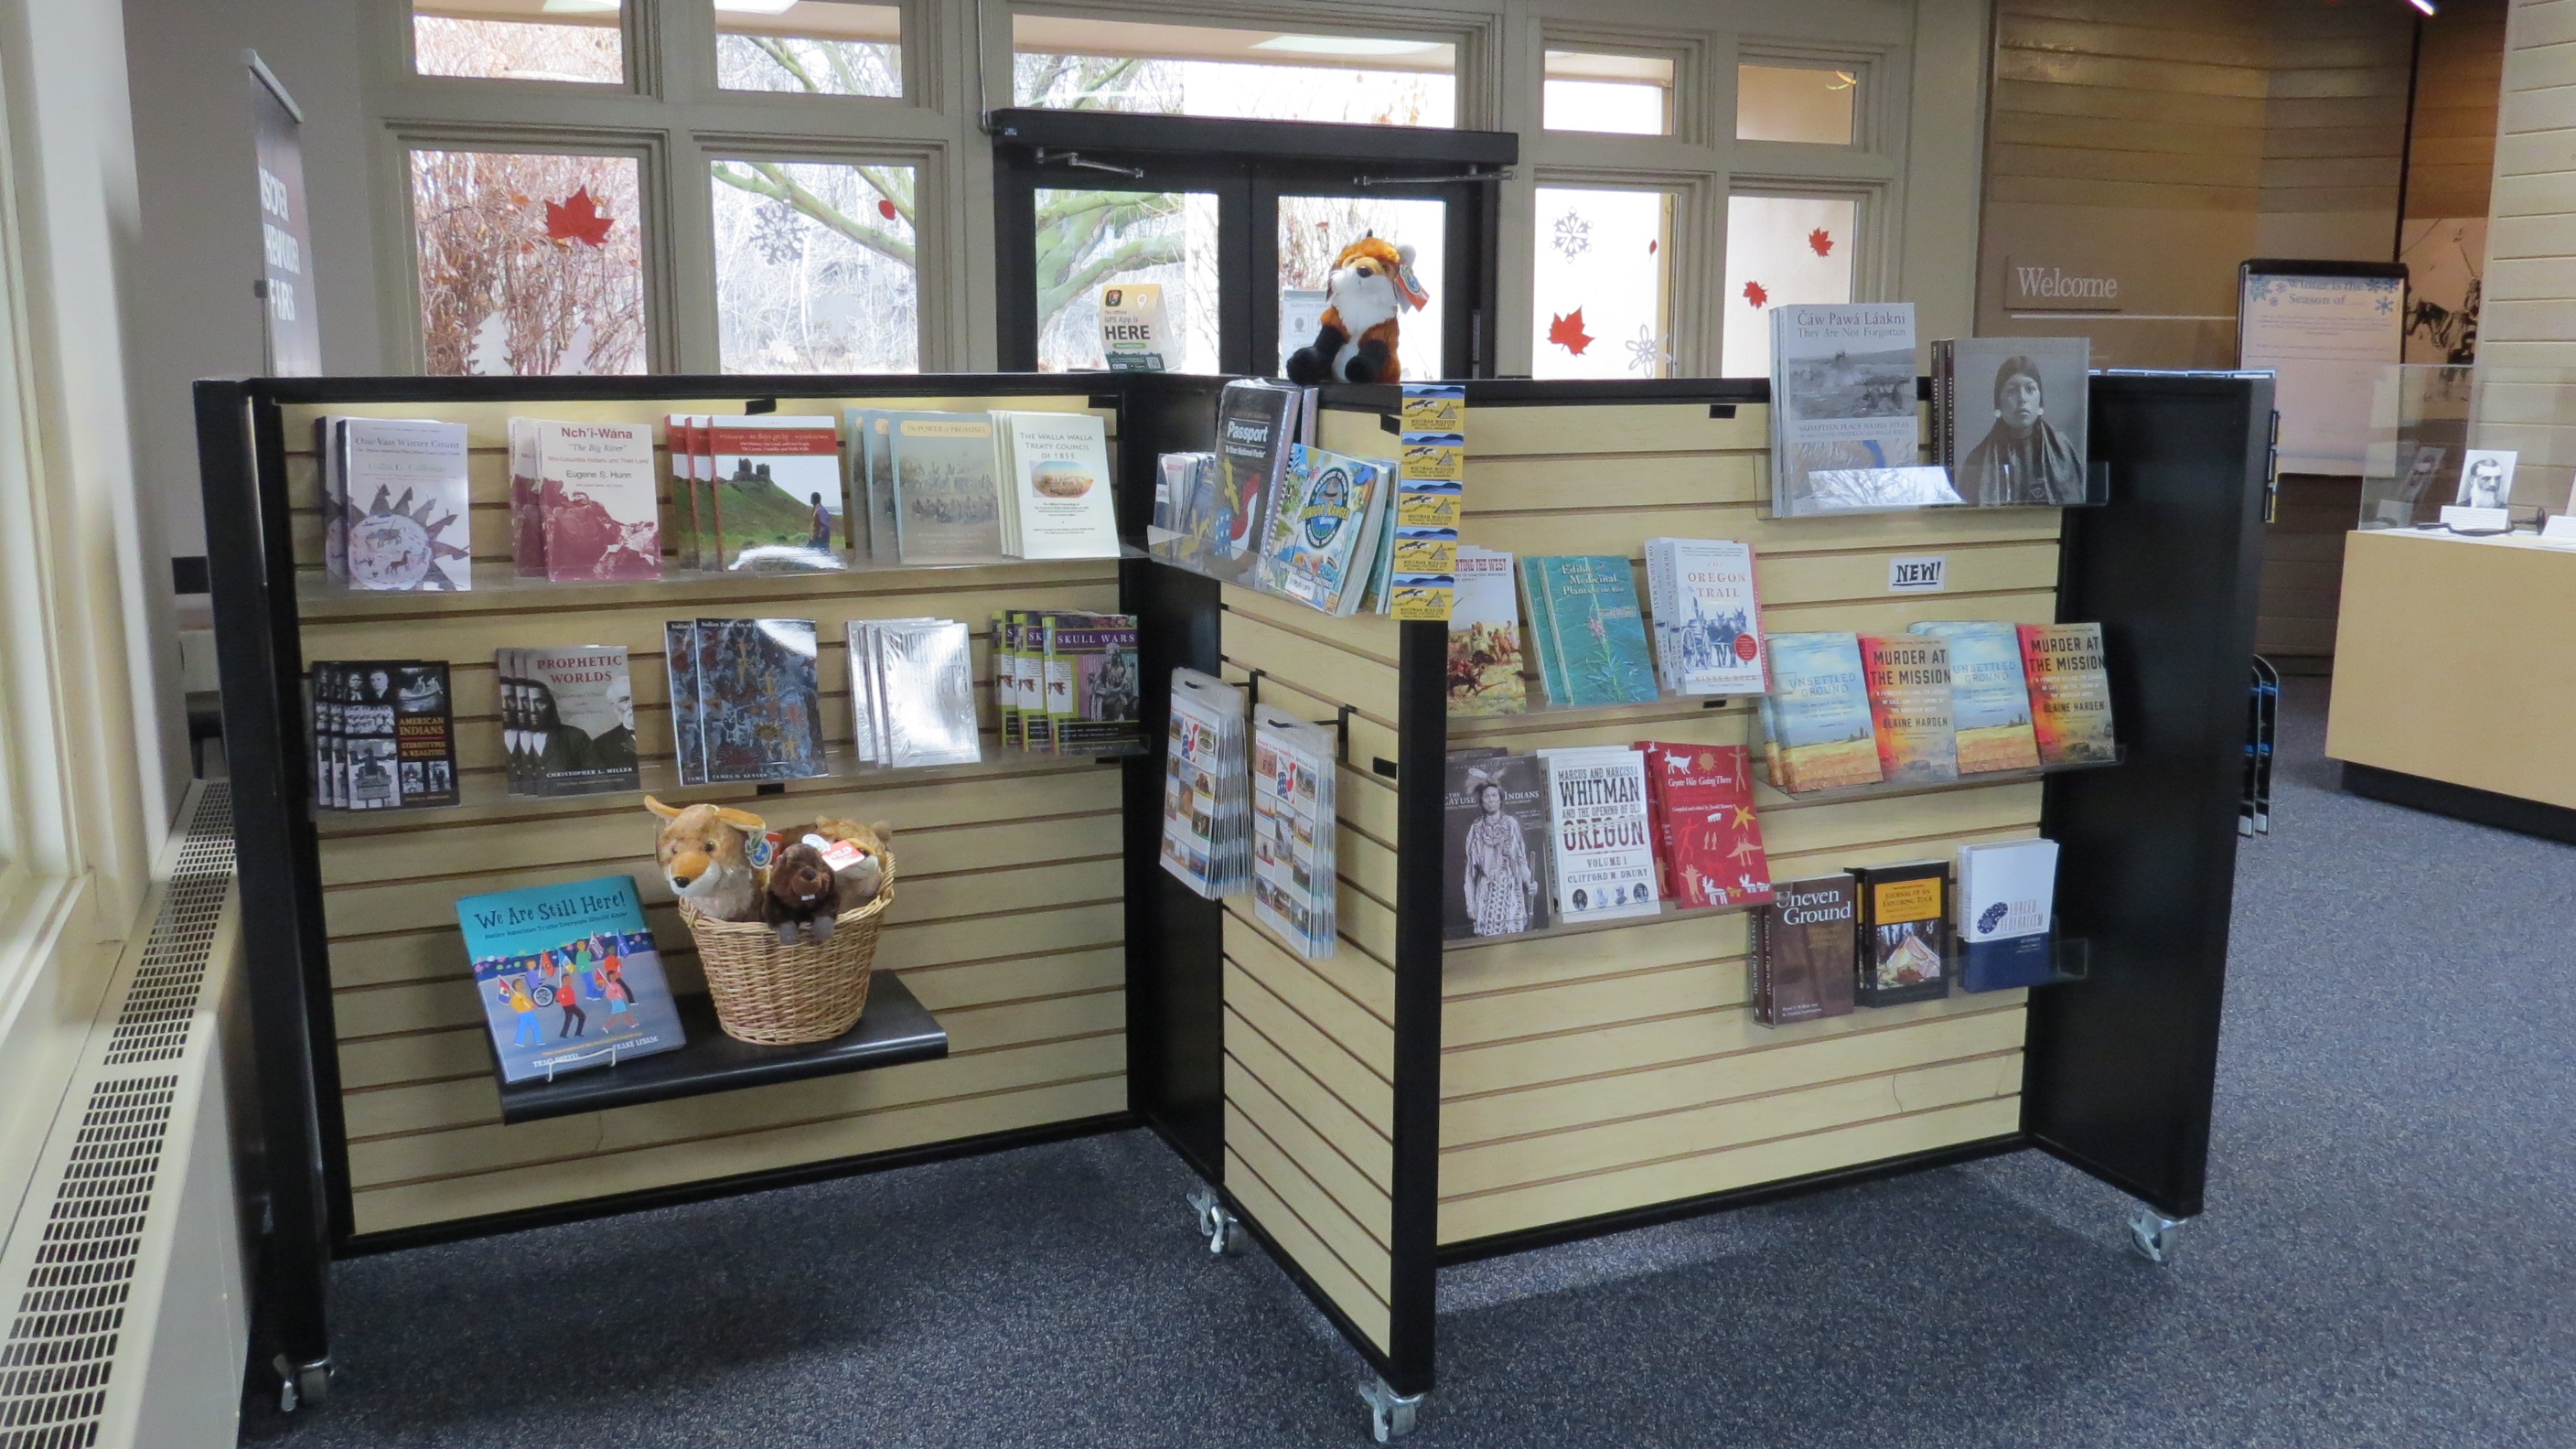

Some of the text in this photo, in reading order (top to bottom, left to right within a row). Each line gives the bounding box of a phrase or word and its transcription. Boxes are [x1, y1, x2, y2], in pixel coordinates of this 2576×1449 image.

[2017, 267, 2118, 298] Welcome
[2289, 294, 2330, 305] Season
[2333, 295, 2347, 306] of
[1830, 312, 1860, 326] Pawá
[1864, 311, 1905, 326] Láakni
[1104, 325, 1151, 340] HERE
[1798, 327, 1906, 340] They Are Not Forgotten
[1227, 421, 1269, 444] Passport
[588, 445, 602, 453] Big
[1025, 442, 1090, 451] TREATY COUNCIL
[566, 469, 597, 479] Eugene
[610, 471, 632, 479] Hunn
[1298, 500, 1351, 523] JUNIOR RANGER
[1476, 559, 1487, 571] THE
[1488, 559, 1507, 571] WEST
[1562, 564, 1593, 574] Edible
[1688, 573, 1746, 583] OREGON
[1895, 561, 1941, 583] NEW!
[1570, 574, 1617, 585] Medicinal
[1562, 585, 1592, 595] Plants
[1697, 587, 1740, 597] TRAIL
[1057, 633, 1135, 644] SKULL WARS
[2032, 637, 2099, 653] MURDER AT
[537, 655, 623, 670] PROPHETIC
[1873, 649, 1947, 665] MURDER AT
[2029, 655, 2105, 672] THE MISSION
[1952, 661, 2016, 674] UNSETTLED
[551, 671, 612, 684] WORLDS
[1789, 672, 1856, 688] UNSETTLED
[1869, 670, 1951, 686] THE MISSION
[1964, 671, 2009, 682] GROUND
[1801, 684, 1849, 697] GROUND
[2044, 701, 2105, 713] BLAINE HARDEN
[400, 717, 445, 725] AMERICAN
[1883, 716, 1948, 728] BLAINE HARDEN
[400, 725, 445, 735] INDIANS
[1558, 766, 1639, 780] MARCUS AND NARCISSA
[1668, 775, 1733, 788] Coyote Was Going There
[1504, 790, 1540, 800] INDIANS
[1559, 777, 1640, 807] WHITMAN
[1562, 803, 1641, 819] AND THE OPENING OF OLD
[1562, 815, 1646, 852] OREGON
[1587, 856, 1627, 868] VOLUME 1
[1567, 871, 1608, 885] CLIFFORD
[1620, 868, 1648, 878] DRURY
[1776, 889, 1840, 909] Uneven
[1885, 891, 1912, 900] JOURNAL
[1883, 898, 1915, 907] EXPLORING
[2010, 899, 2037, 917] FORCED
[474, 891, 626, 929] We Are Still Here!
[1784, 901, 1852, 926] Ground
[2001, 912, 2044, 932] FEDERALISM
